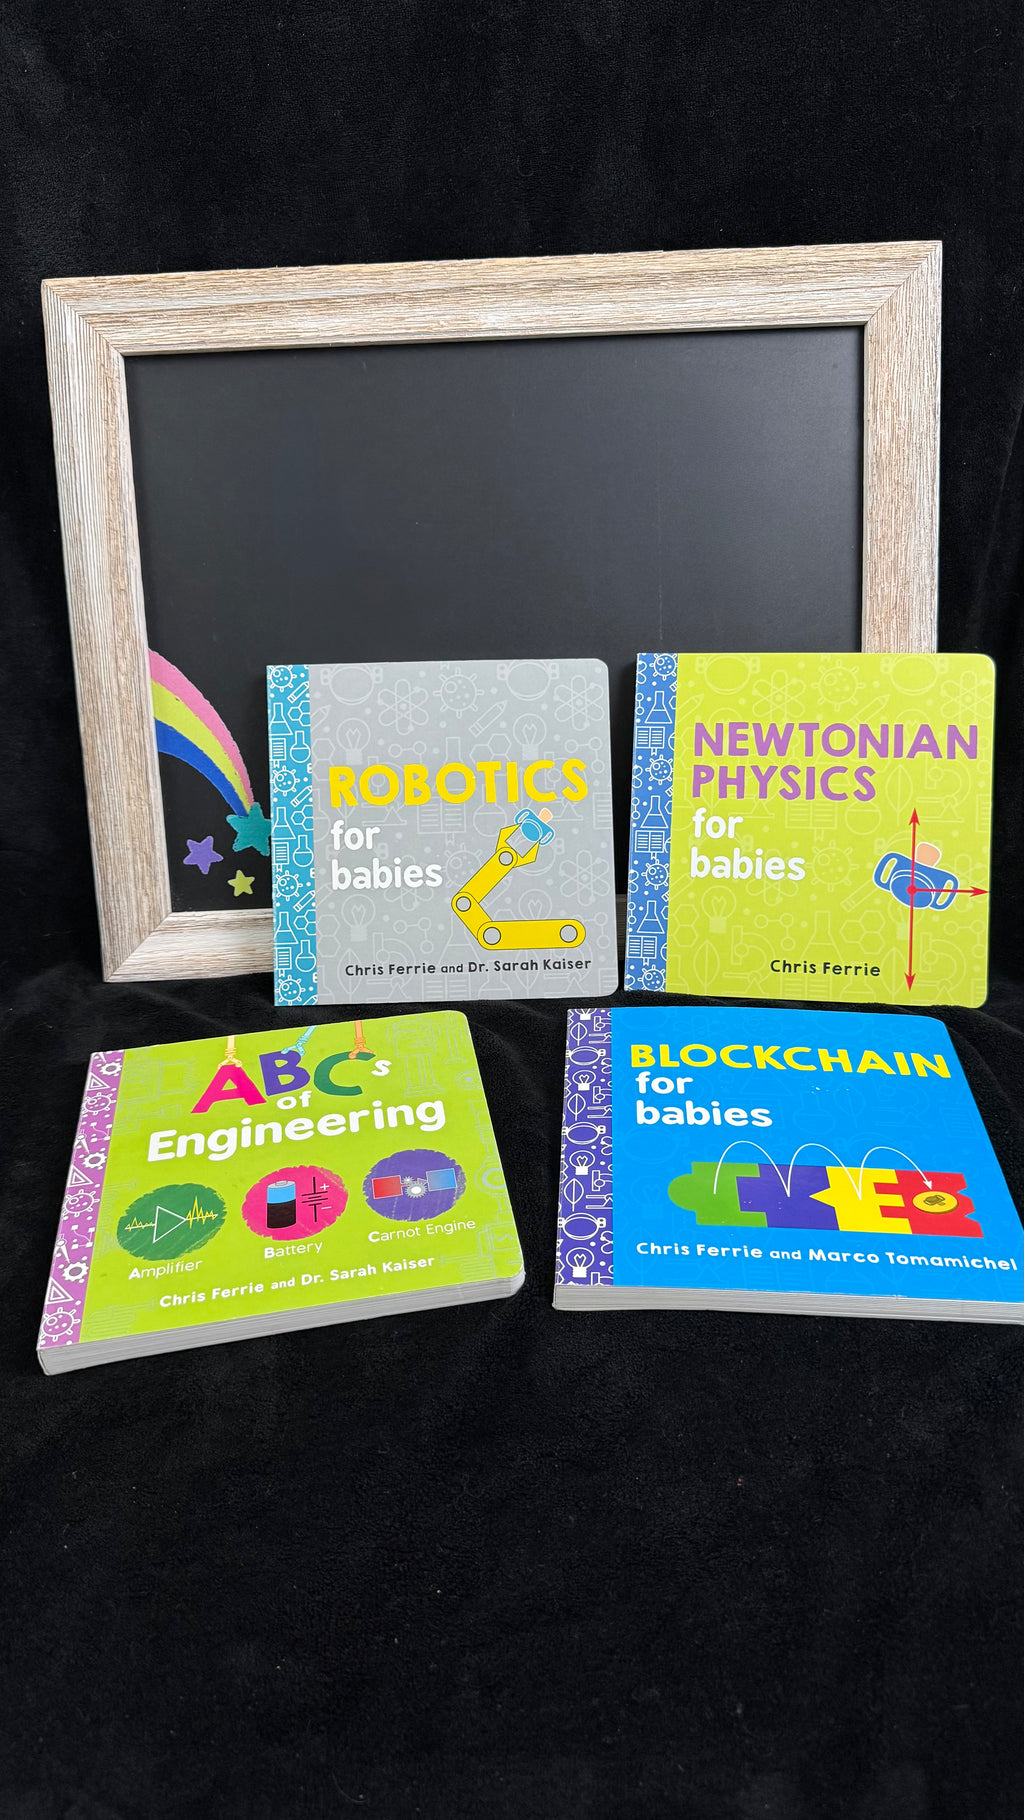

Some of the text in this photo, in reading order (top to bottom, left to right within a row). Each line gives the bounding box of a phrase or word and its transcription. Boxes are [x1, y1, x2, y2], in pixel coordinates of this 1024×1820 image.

[693, 722, 978, 760] NEWTONIAN
[328, 758, 589, 808] ROBOTICS
[691, 764, 876, 802] PHYSICS
[330, 819, 381, 850] for
[692, 807, 744, 839] for
[330, 857, 443, 891] babies
[689, 846, 806, 881] babies
[345, 957, 592, 977] Chris Ferrie and Dr. Sarah Kaiser
[769, 958, 881, 977] Chris Ferrie
[630, 1043, 951, 1079] BLOCKCHAIN
[190, 1049, 392, 1114] ABCs
[635, 1071, 694, 1095] for
[276, 1090, 312, 1111] of
[635, 1100, 773, 1128] babies
[146, 1100, 447, 1163] Engineering
[367, 1217, 476, 1244] Carnot Engine
[263, 1240, 324, 1260] Battery
[636, 1242, 1019, 1271] Chris Ferrie and Marco Tomamichel
[127, 1258, 203, 1281] Amplifier
[159, 1254, 435, 1308] Chris Ferrie and Dr. Sarah Kaiser
